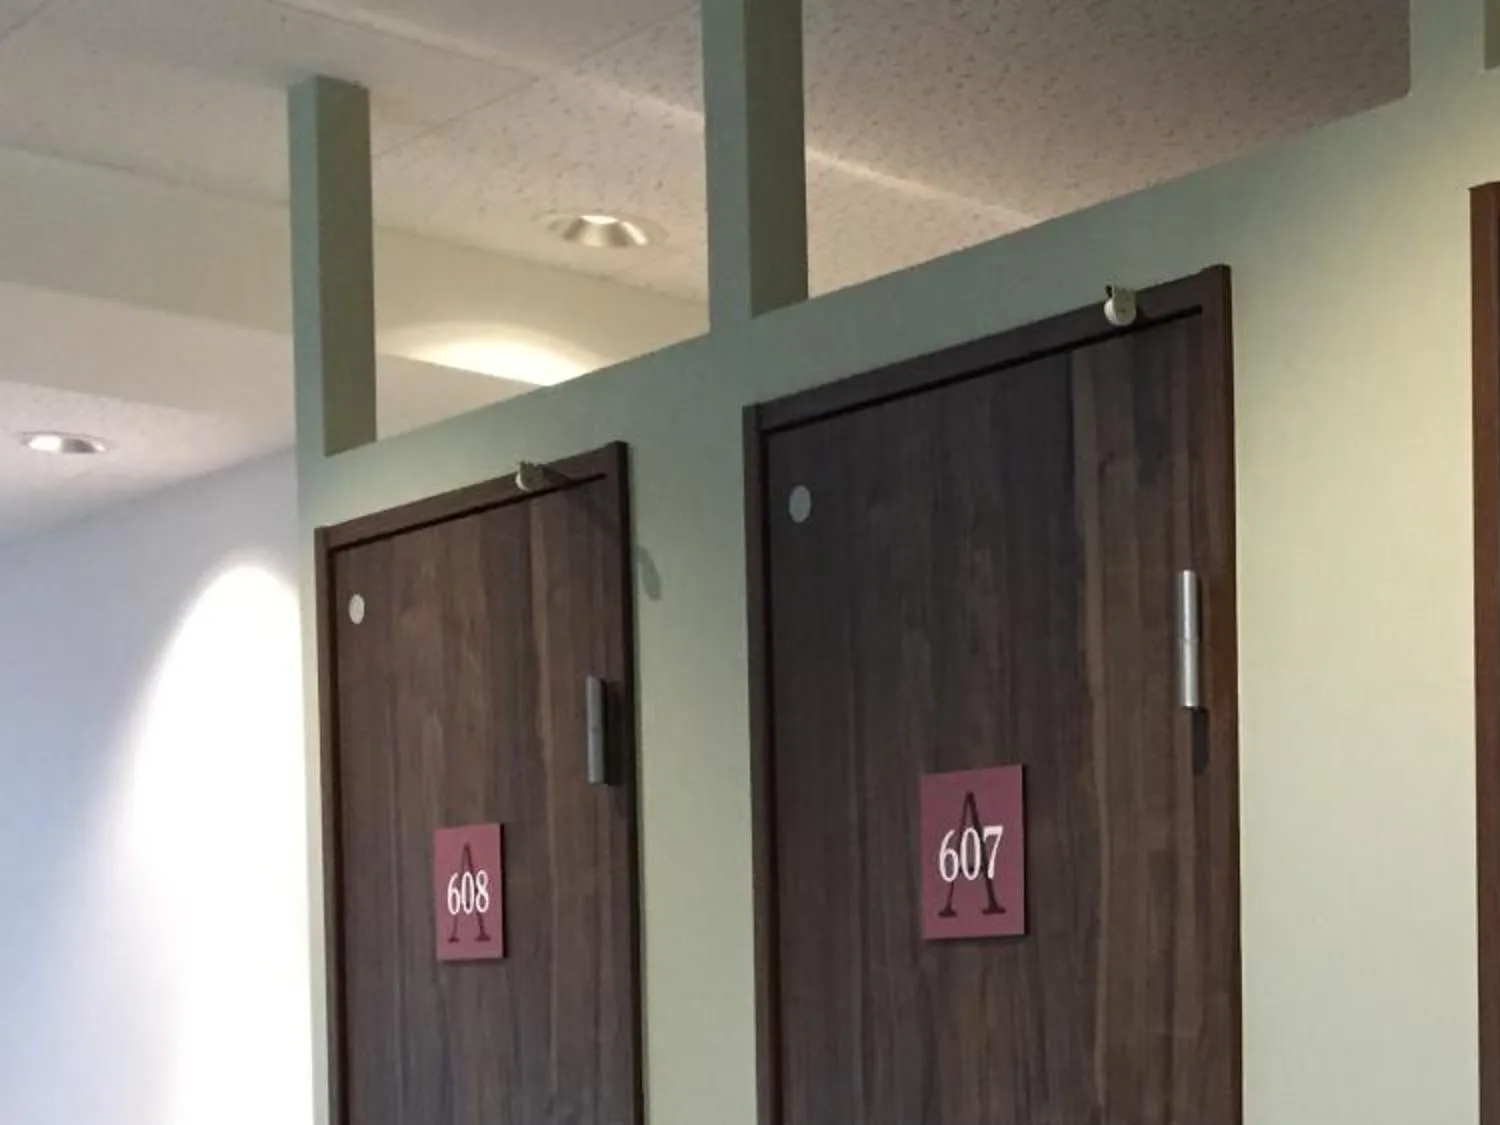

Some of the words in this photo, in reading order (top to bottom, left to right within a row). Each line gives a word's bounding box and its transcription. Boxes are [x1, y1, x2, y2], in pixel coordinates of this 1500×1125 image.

[447, 869, 490, 915] 608
[447, 842, 492, 944] A
[938, 791, 1006, 917] A
[939, 825, 1004, 882] 607
